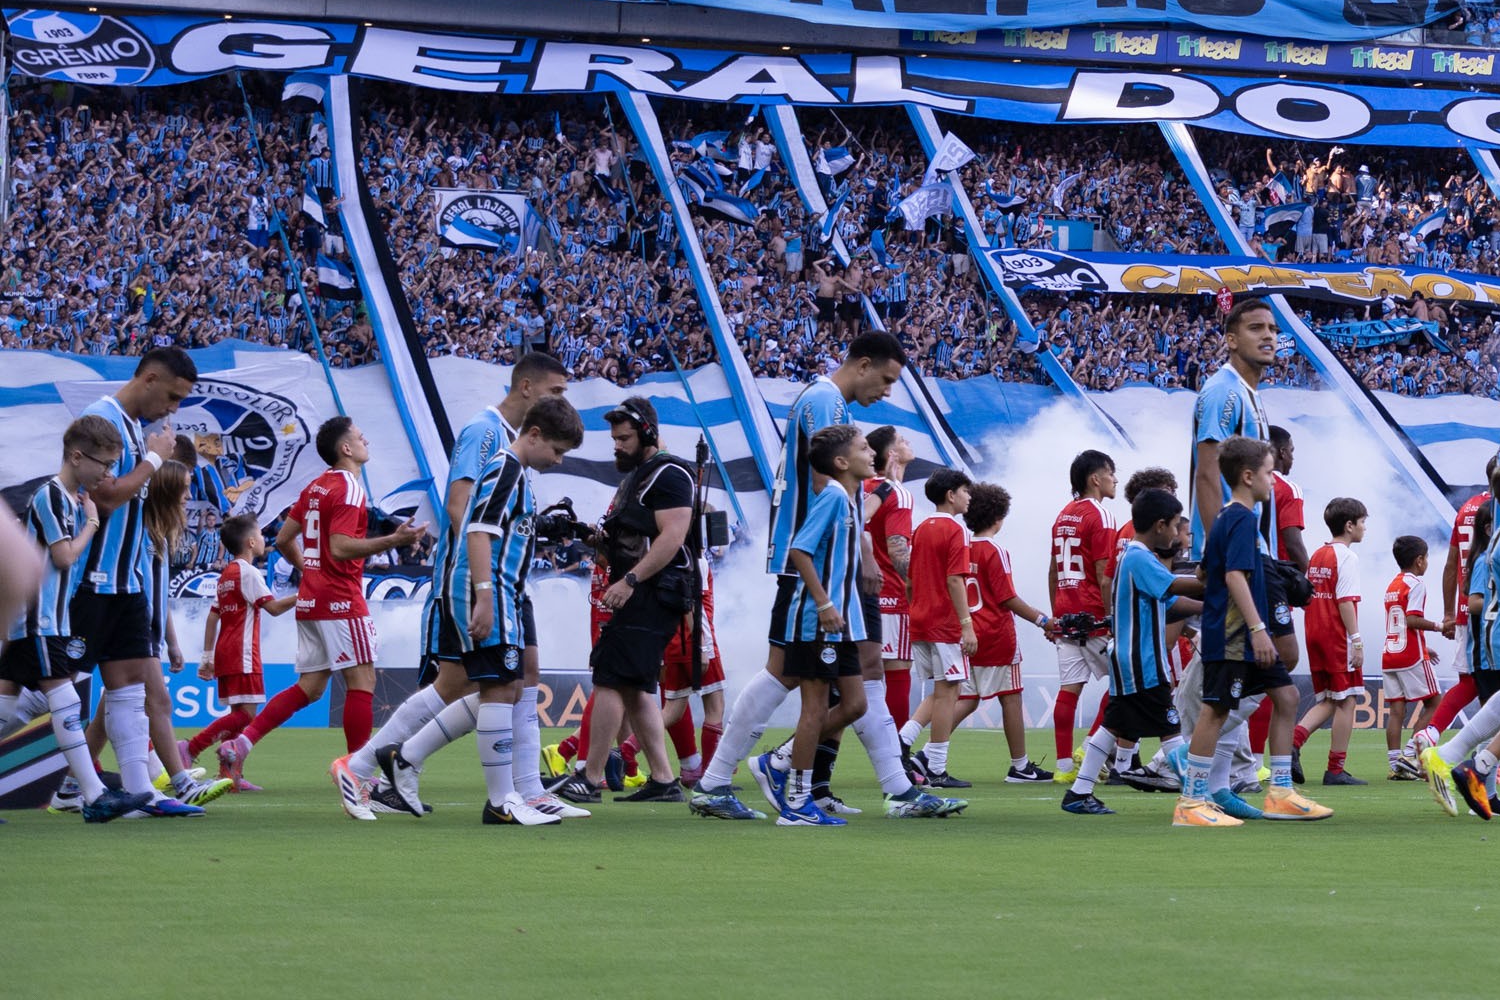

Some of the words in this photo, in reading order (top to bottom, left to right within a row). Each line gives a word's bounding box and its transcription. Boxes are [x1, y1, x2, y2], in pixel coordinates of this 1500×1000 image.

[43, 27, 74, 39] 1903
[1092, 30, 1159, 56] Trilegal
[1177, 34, 1243, 60] Trilegal
[16, 37, 141, 67] GRÊMIO
[1264, 41, 1329, 67] Trilegal
[1351, 46, 1415, 72] Trilegal
[1432, 51, 1495, 77] Trilegal
[170, 21, 972, 112] GERAL
[1062, 70, 1372, 140] DO
[477, 198, 519, 229] LAJEADO
[1120, 264, 1475, 302] CAMPEÃO
[190, 382, 293, 425] RICOLOR
[833, 396, 844, 425] AVAN
[1054, 536, 1087, 581] 26
[965, 577, 983, 613] 0
